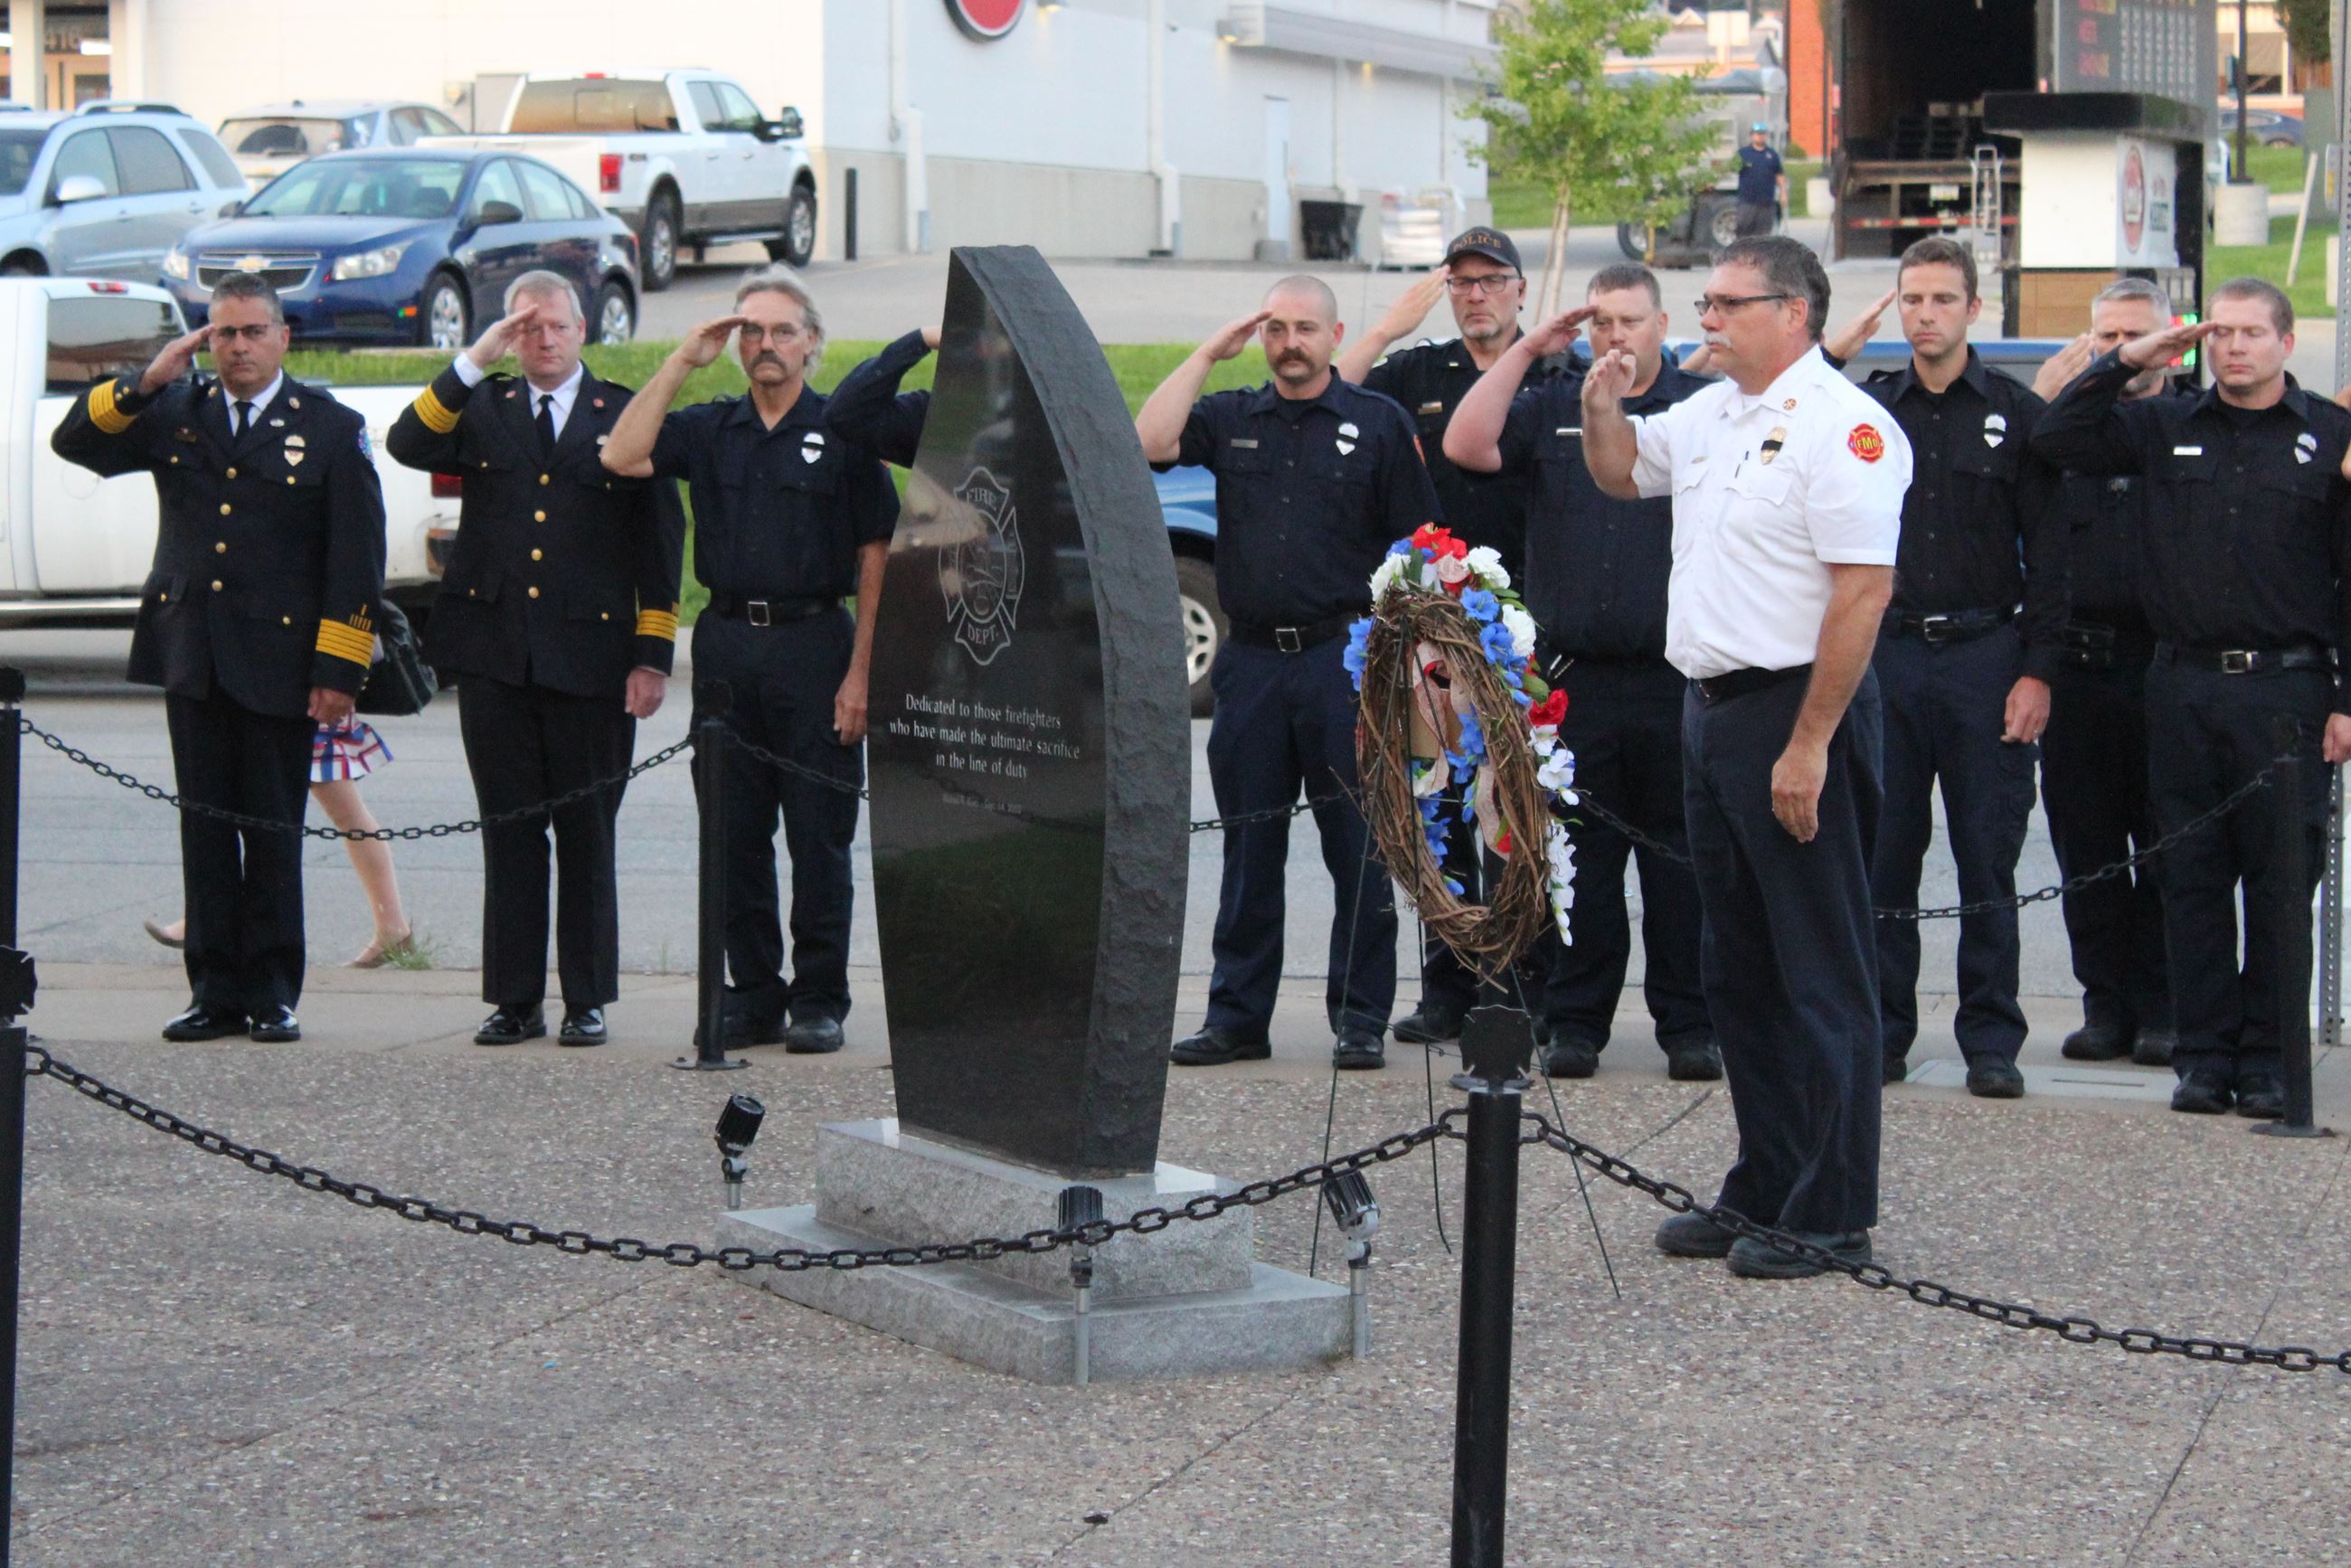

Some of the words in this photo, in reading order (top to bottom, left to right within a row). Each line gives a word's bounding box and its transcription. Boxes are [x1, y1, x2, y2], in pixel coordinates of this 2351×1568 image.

[1453, 235, 1502, 253] POLICE
[966, 486, 998, 512] FIRE
[906, 694, 955, 716] Dedicated
[959, 703, 970, 717] to
[974, 702, 1001, 722] those
[1006, 704, 1061, 731] firefighters
[890, 718, 911, 735] who
[913, 720, 936, 739] have
[939, 726, 967, 742] made
[970, 729, 987, 746] the
[991, 732, 1033, 752] ultimate
[1036, 739, 1080, 760] sacrifice
[936, 753, 946, 767] in
[949, 752, 965, 770] the
[969, 753, 987, 773] line
[991, 759, 1002, 775] of
[1006, 760, 1027, 779] duty
